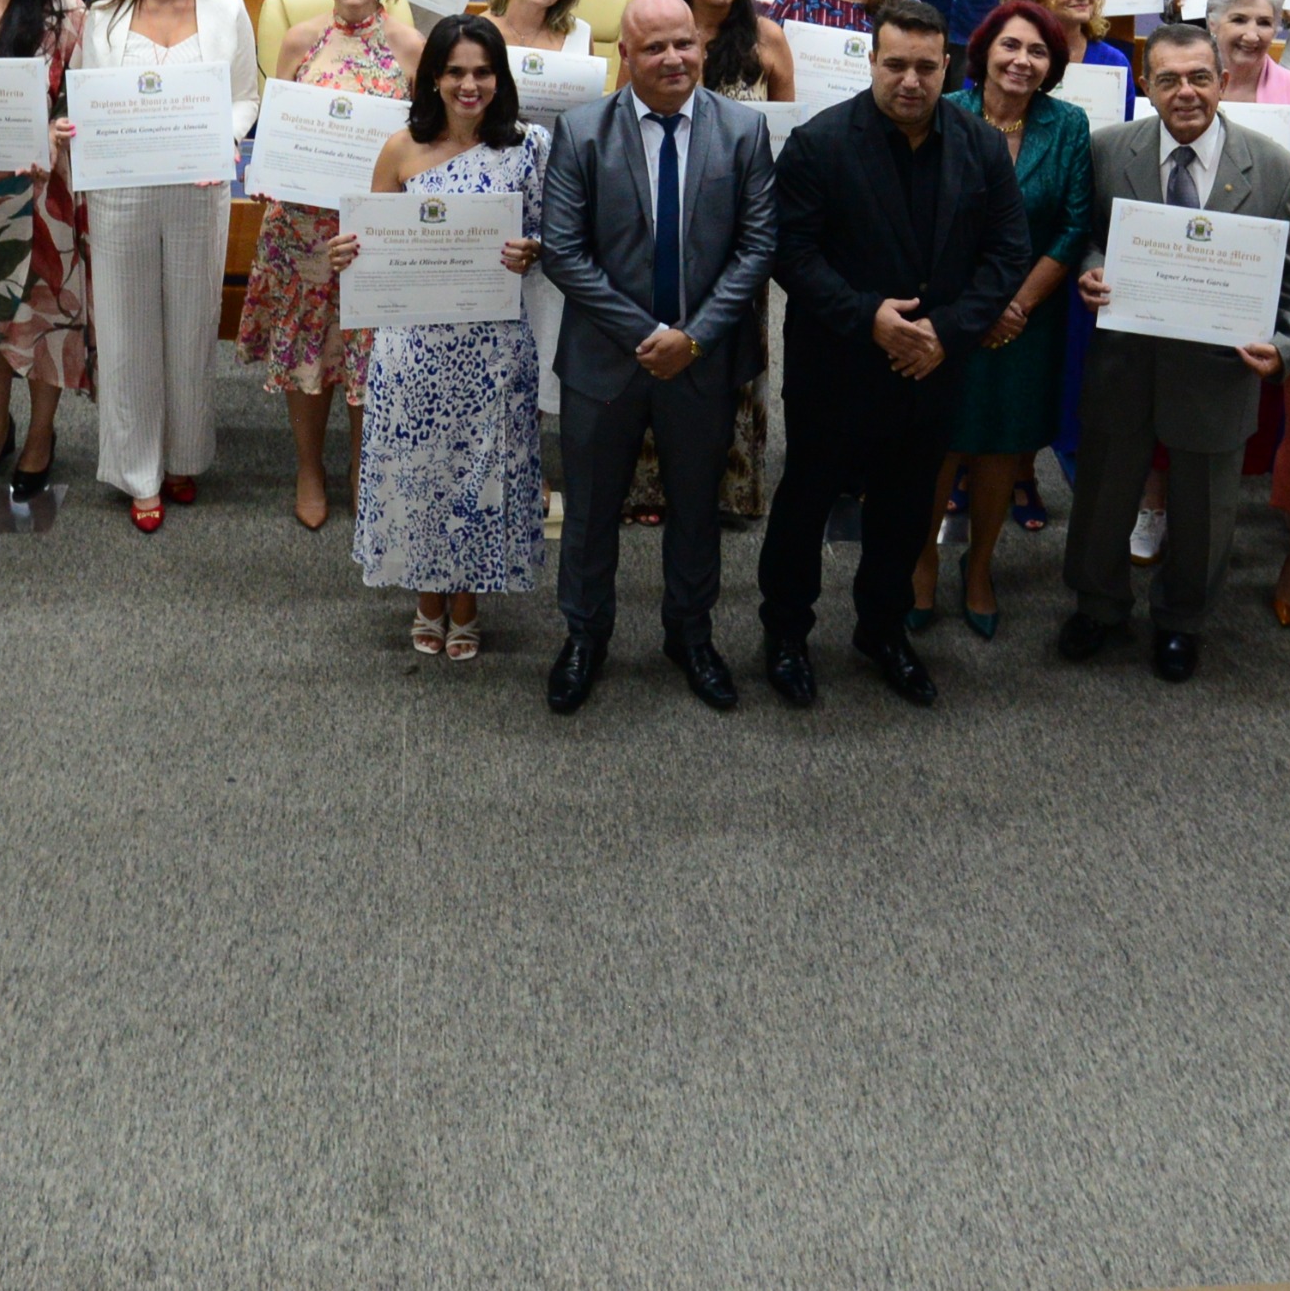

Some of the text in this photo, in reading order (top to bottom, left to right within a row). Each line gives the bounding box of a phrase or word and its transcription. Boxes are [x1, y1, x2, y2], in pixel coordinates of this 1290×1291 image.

[90, 101, 126, 109] Diploma
[365, 227, 405, 237] Diploma
[407, 228, 417, 236] de
[466, 227, 499, 237] Mérito
[1132, 236, 1170, 250] Diploma
[1230, 250, 1261, 263] Mérito
